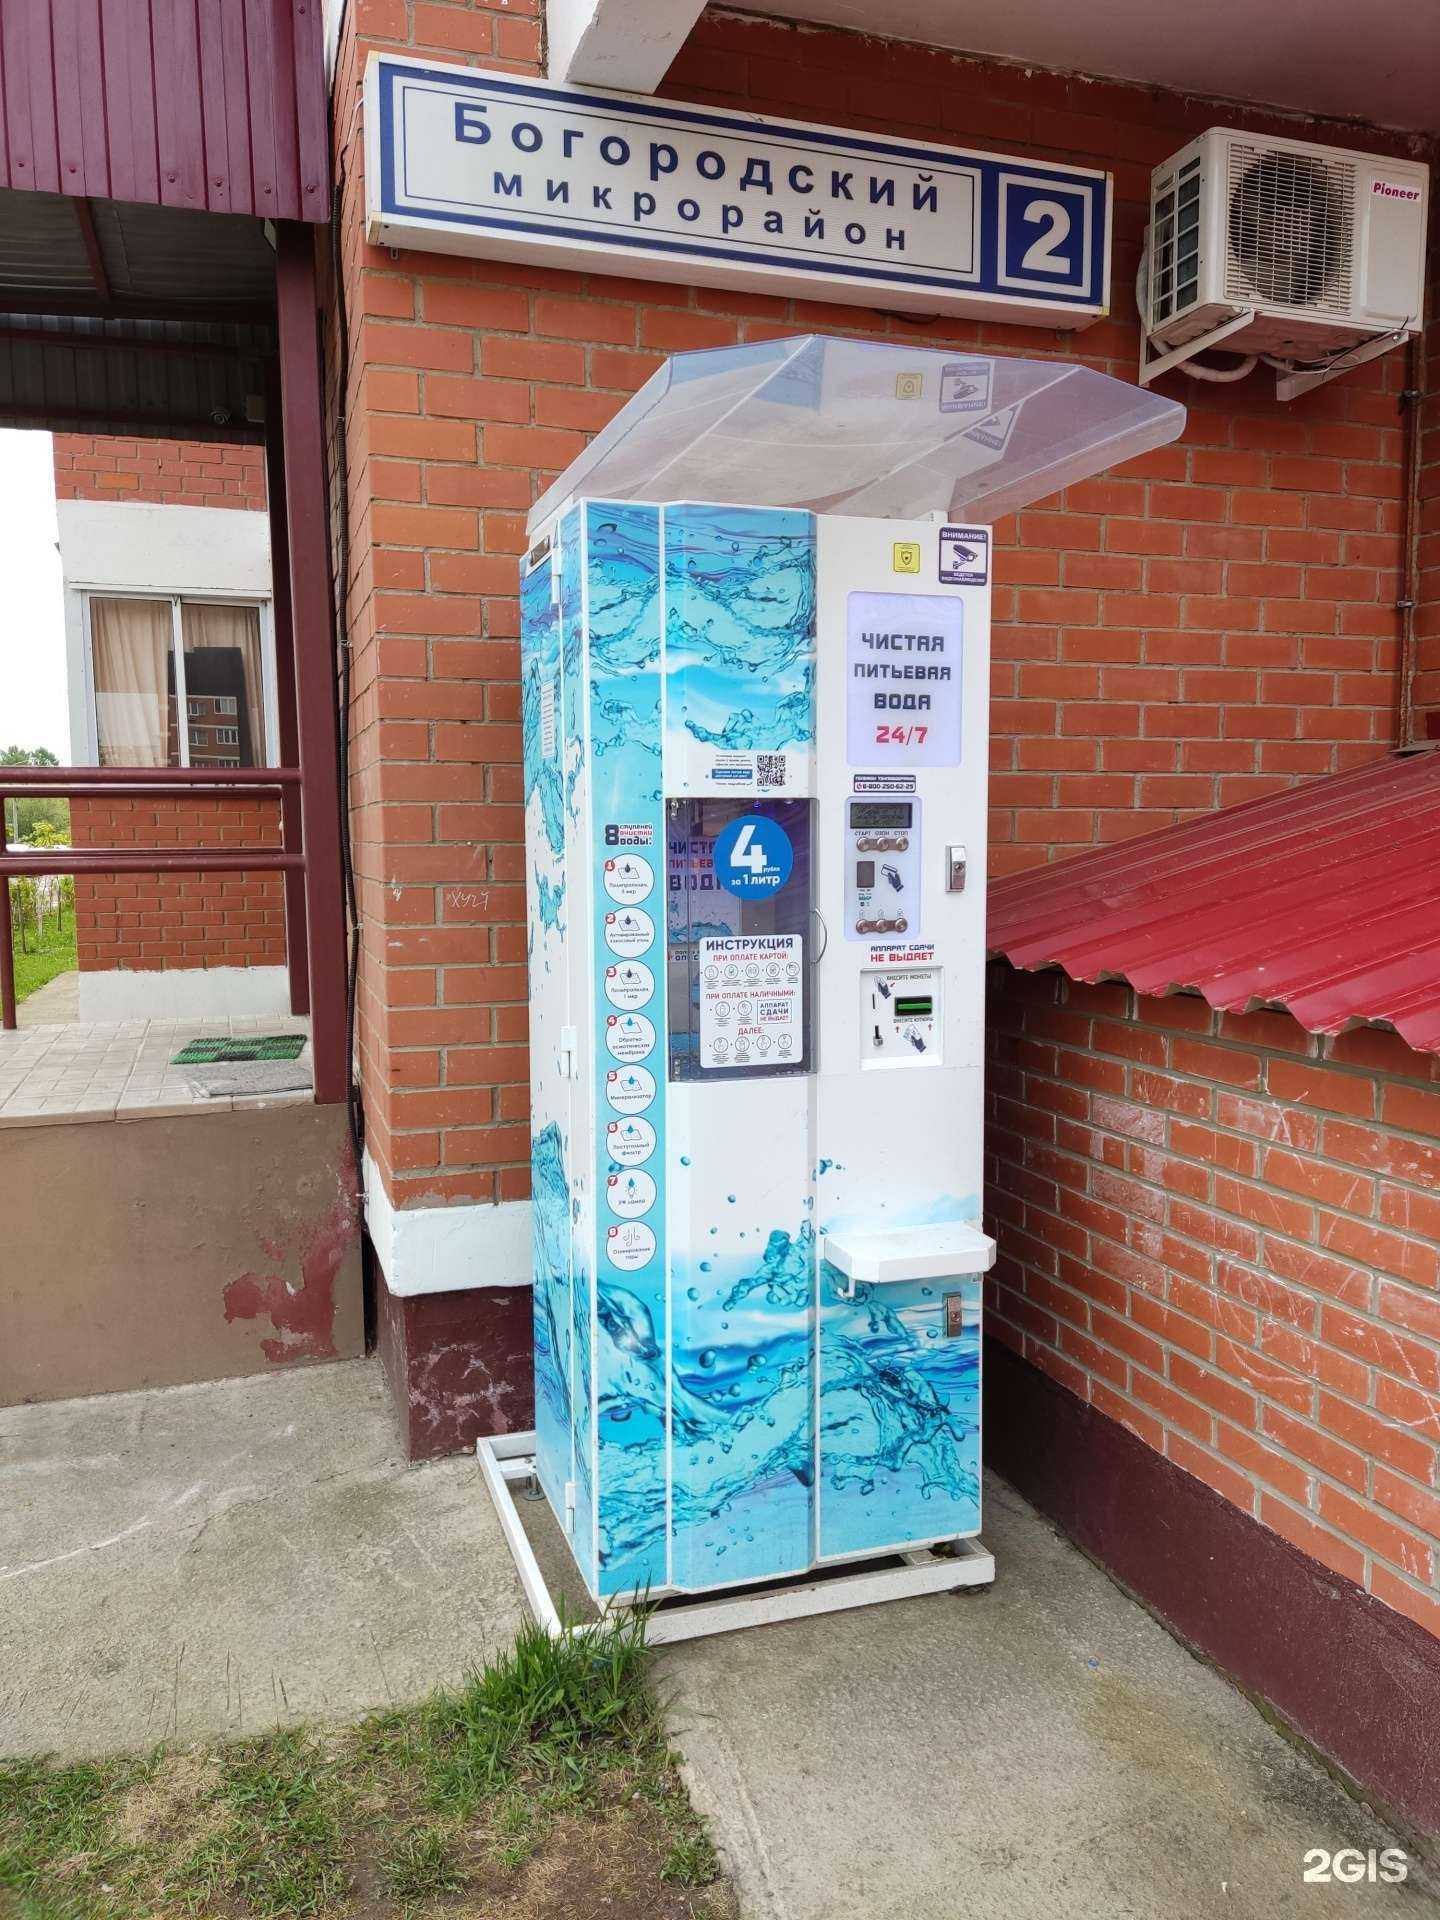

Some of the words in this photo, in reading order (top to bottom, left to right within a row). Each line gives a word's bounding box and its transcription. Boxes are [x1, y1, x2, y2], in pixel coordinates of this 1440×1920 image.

[455, 101, 938, 213] Богородский
[1373, 182, 1420, 200] Pioneer
[494, 171, 905, 251] микрорайон
[1021, 199, 1071, 275] 2
[862, 632, 945, 652] ЧИСТАЯ
[854, 663, 951, 681] ПИТЬЕВАЯ
[874, 693, 931, 710] ВОДА
[876, 725, 928, 745] 24/7
[605, 824, 619, 845] 8
[620, 836, 652, 845] воды:
[730, 824, 767, 873] 4
[743, 874, 749, 885] 1
[750, 875, 780, 887] литр
[706, 938, 793, 950] ИНСТРУКЦИЯ
[871, 944, 906, 952] АППАРАТ
[909, 943, 934, 951] СДАЧИ
[871, 954, 884, 962] НЕ
[889, 952, 934, 961] ВЫДАЕТ
